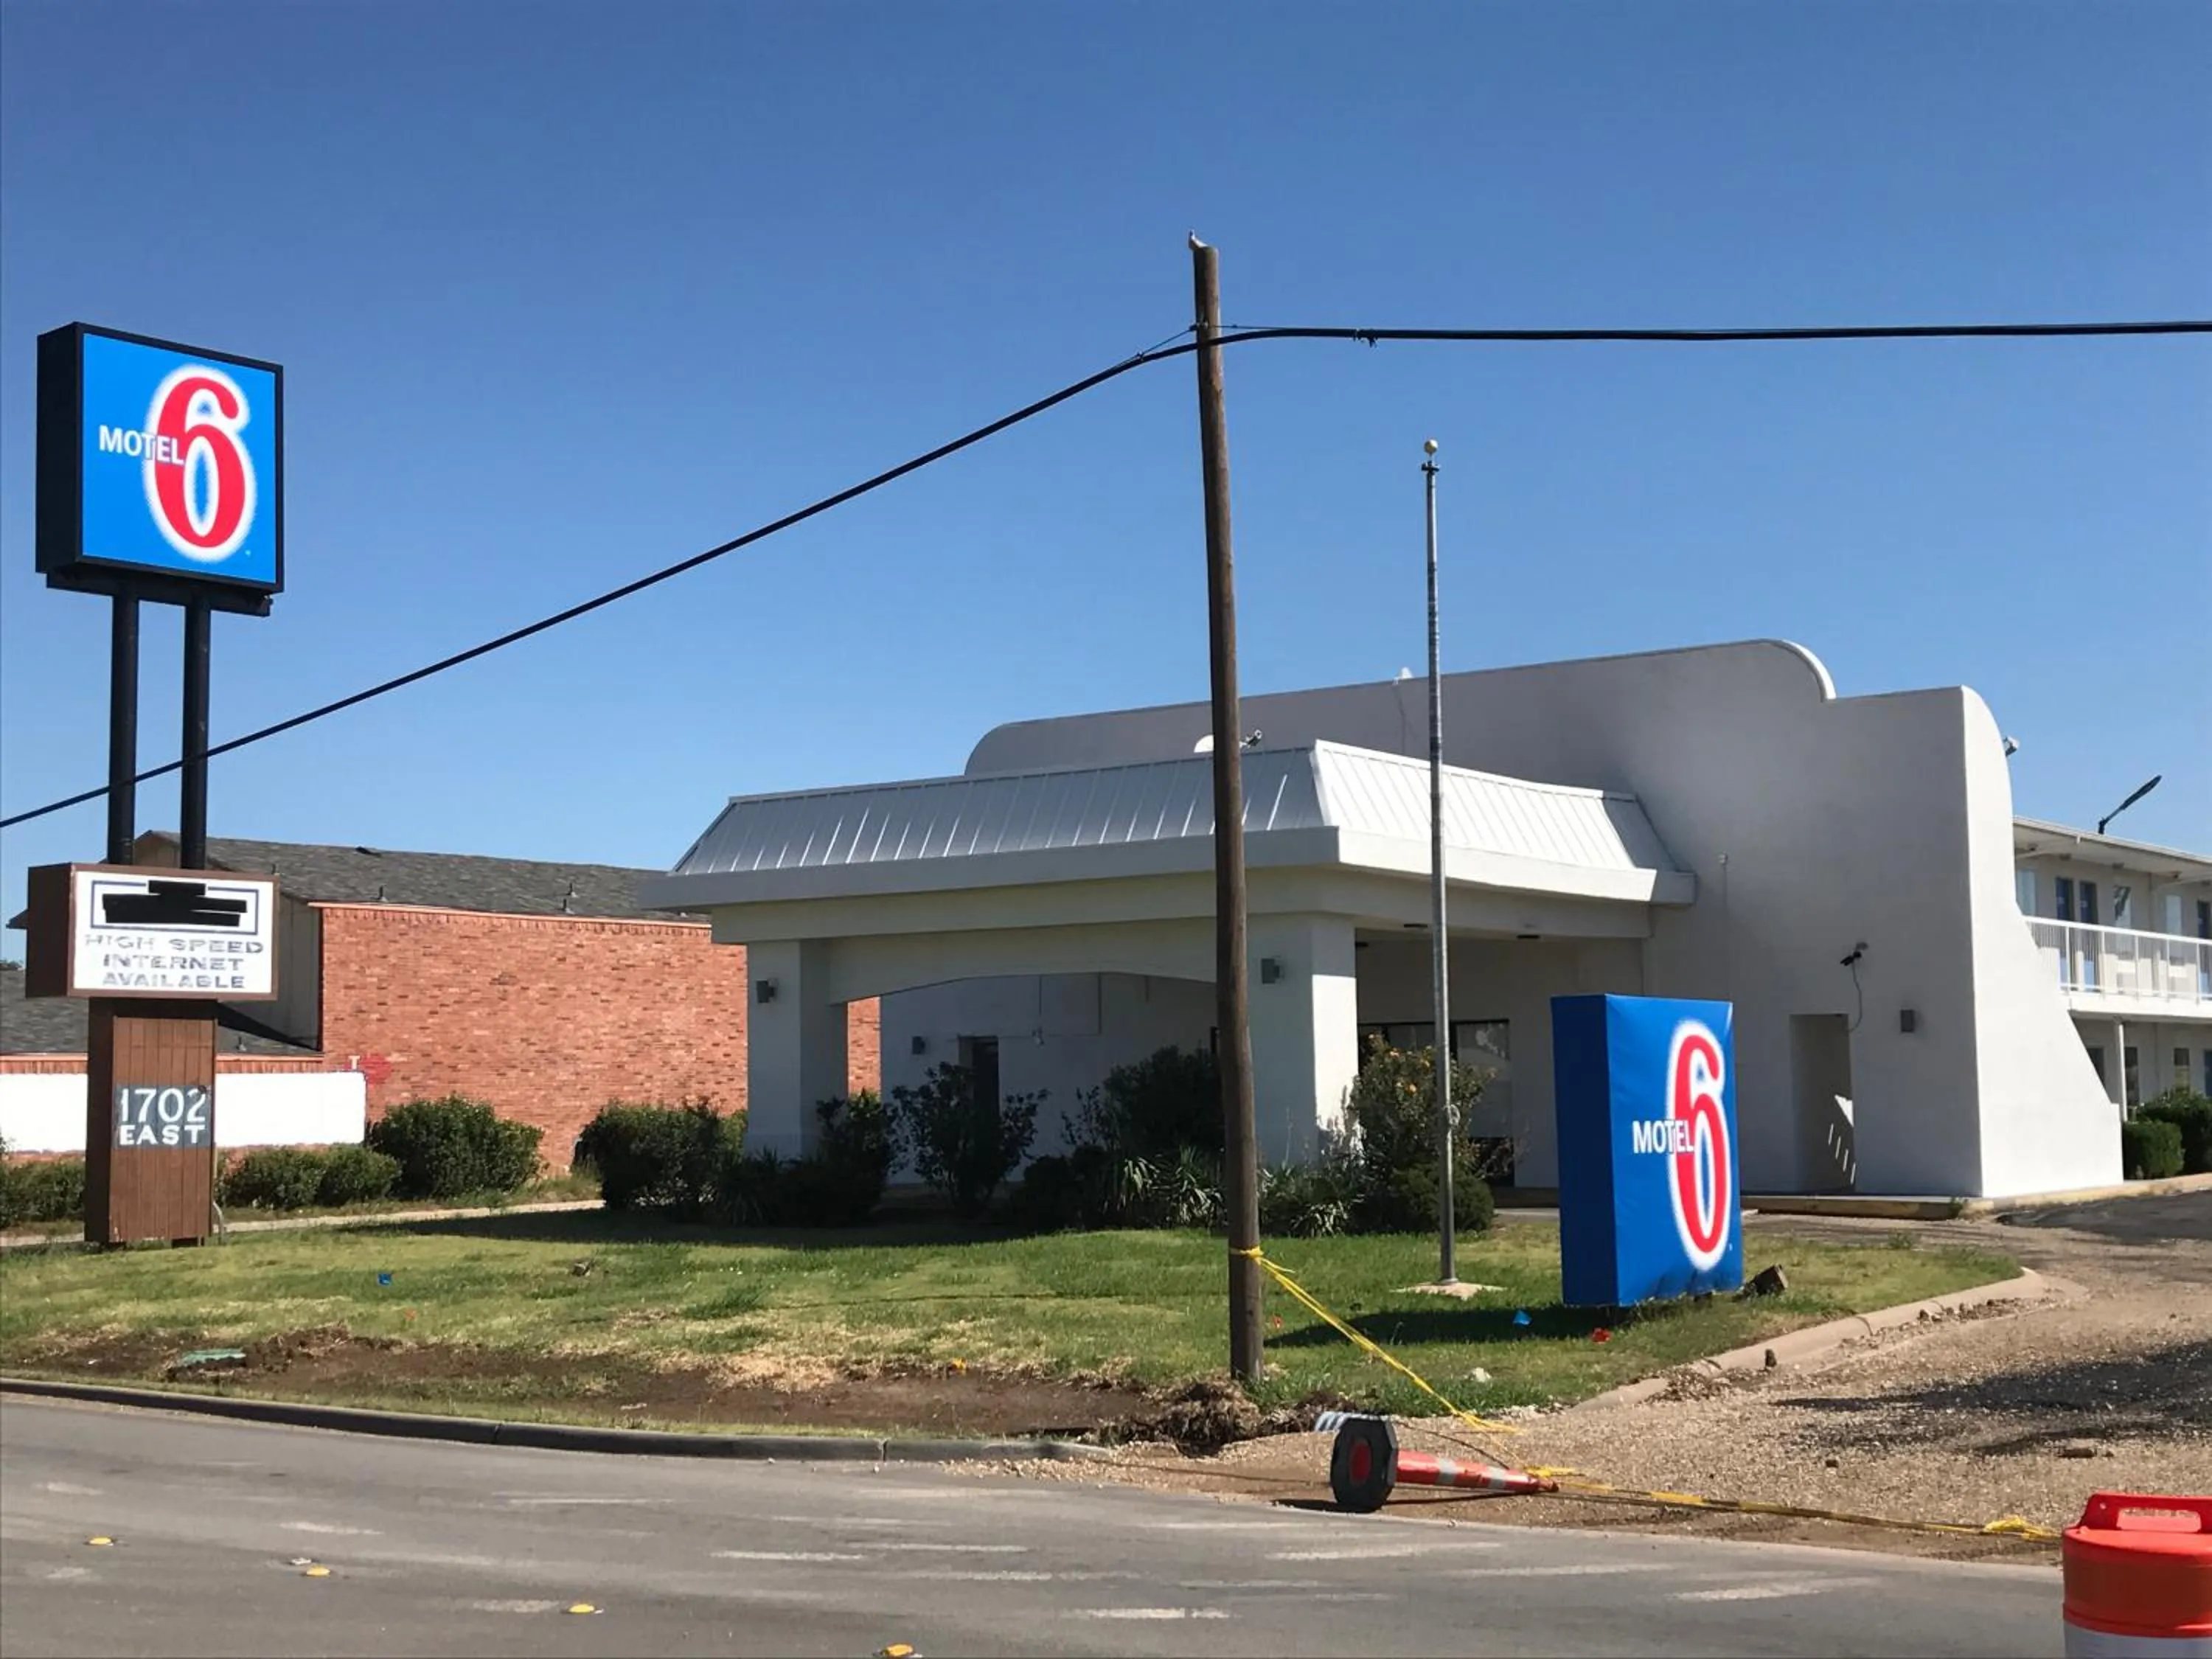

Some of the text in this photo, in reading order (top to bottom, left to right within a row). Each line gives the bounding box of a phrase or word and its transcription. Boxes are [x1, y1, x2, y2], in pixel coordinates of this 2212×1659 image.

[99, 376, 246, 549] MOTEL 6
[169, 939, 264, 953] SPEED
[103, 953, 243, 970] INTERNET
[102, 973, 245, 988] AVAILABLE
[121, 1088, 206, 1123] 1702
[119, 1124, 206, 1145] EAST
[1632, 1034, 1727, 1253] MOTEL 6
